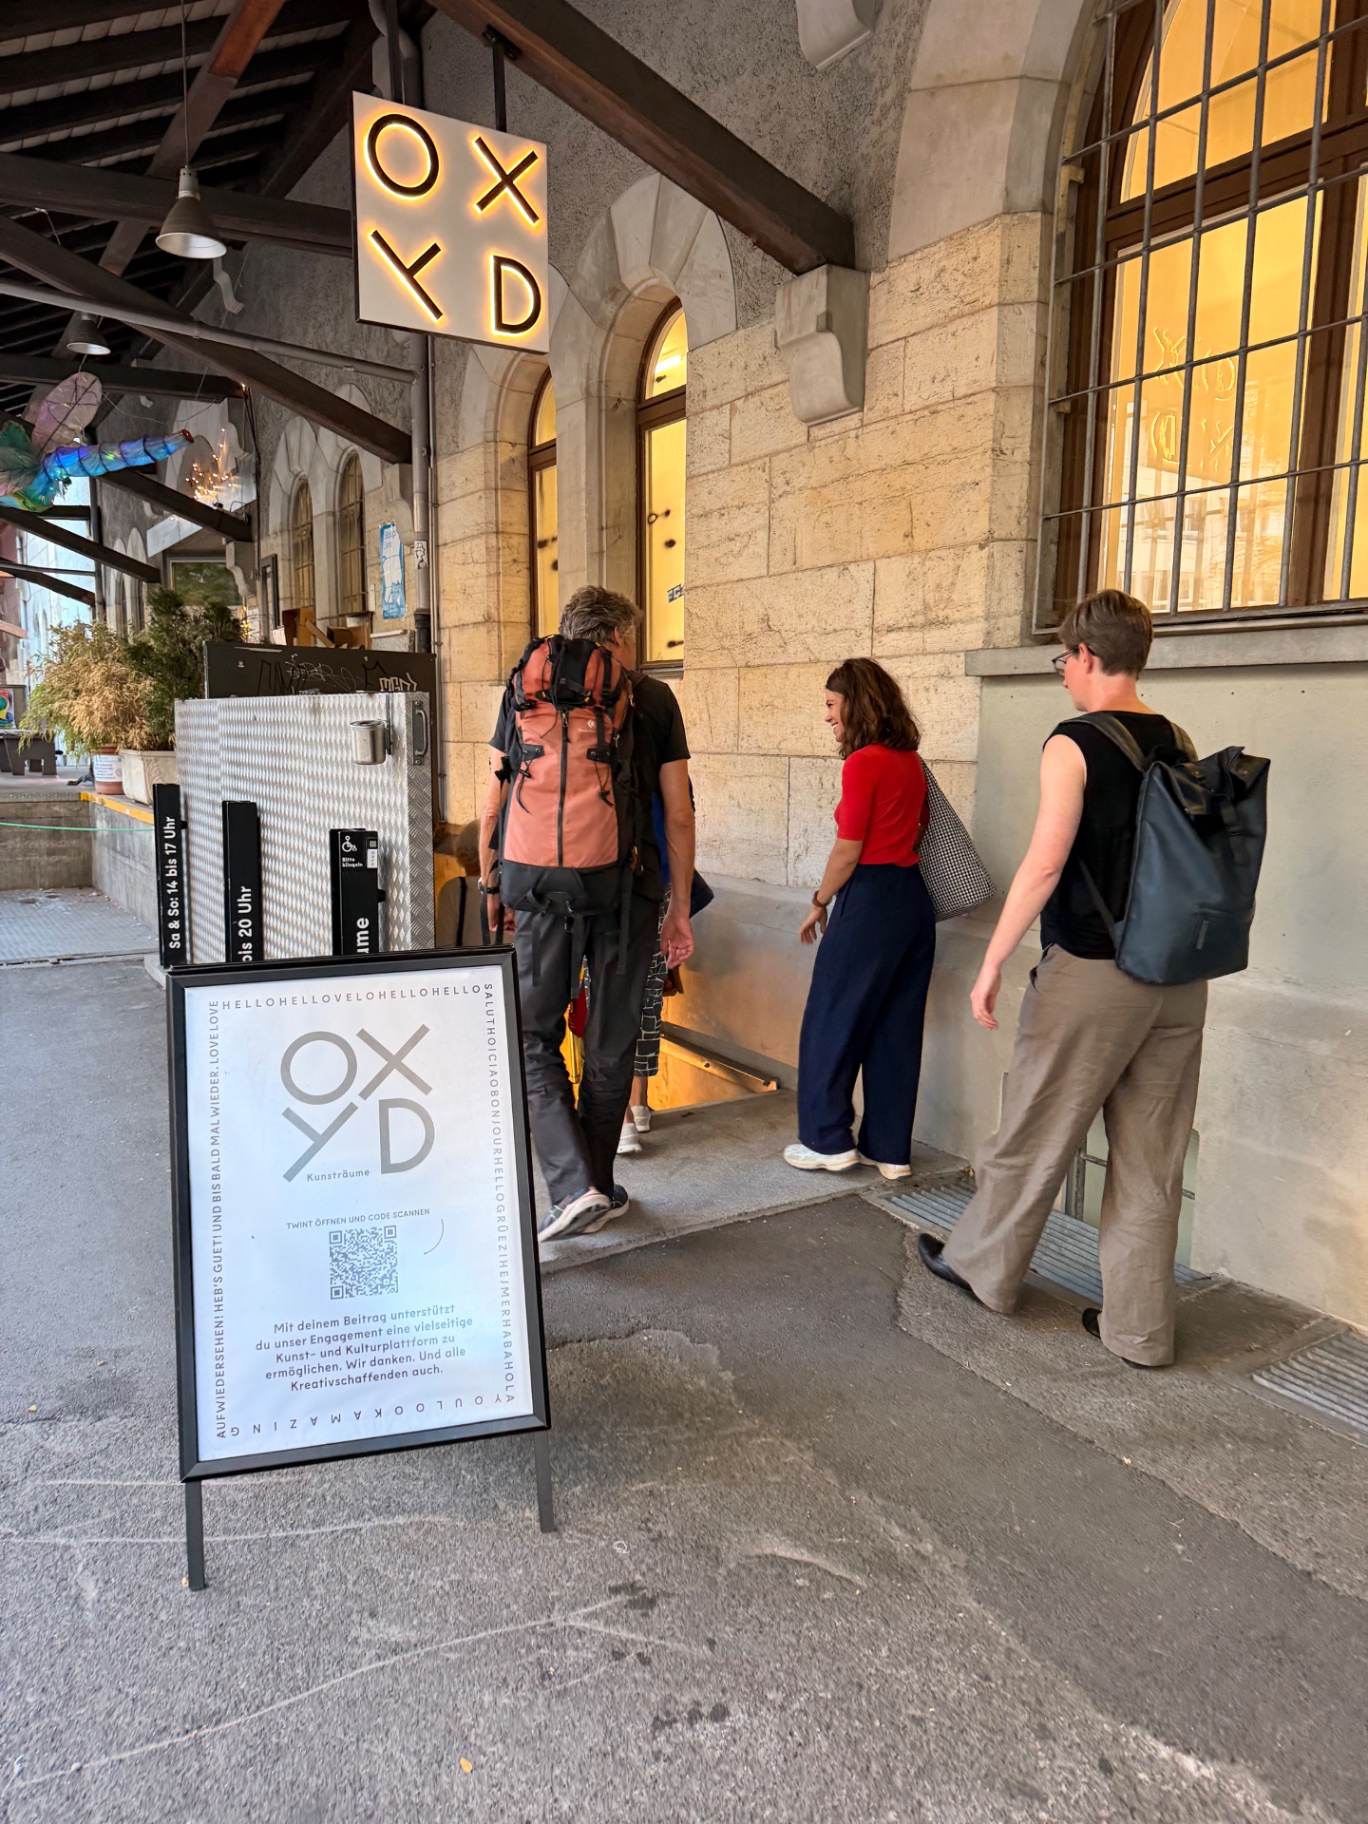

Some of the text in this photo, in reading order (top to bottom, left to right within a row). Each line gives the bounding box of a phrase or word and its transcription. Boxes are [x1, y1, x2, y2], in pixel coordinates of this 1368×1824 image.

[164, 816, 181, 949] Sa & So: 14 bis 17 Uhr
[238, 886, 252, 914] Uhr
[238, 919, 252, 937] 20
[222, 984, 481, 1010] HELLOHELLOVELOHELLOHELLO
[208, 1001, 219, 1031] LOVE
[209, 1034, 220, 1064] LOVE
[210, 1067, 220, 1118] WIEDER.
[210, 1120, 220, 1146] MAL
[210, 1149, 221, 1180] BALD
[306, 1170, 370, 1182] Kunsträume
[211, 1184, 222, 1202] BIS
[212, 1206, 222, 1232] UND
[286, 1208, 430, 1230] TWINT ÖFFNEN UND CODE SCANNEN
[212, 1236, 222, 1272] GUET!
[256, 1317, 473, 1350] du unser Engagement eine vielseitige
[274, 1304, 455, 1334] Mit deinem Beitrag unterstützt
[266, 1346, 466, 1379] ermöglichen. Wir danken. Und alle
[276, 1335, 454, 1363] Kunst- und Kulturplattform zu
[214, 1315, 226, 1438] AUFWIEDERSEHEN!
[291, 1364, 443, 1391] Kreativschaffenden auch.
[230, 1394, 501, 1436] YOULOOKAMAZING
